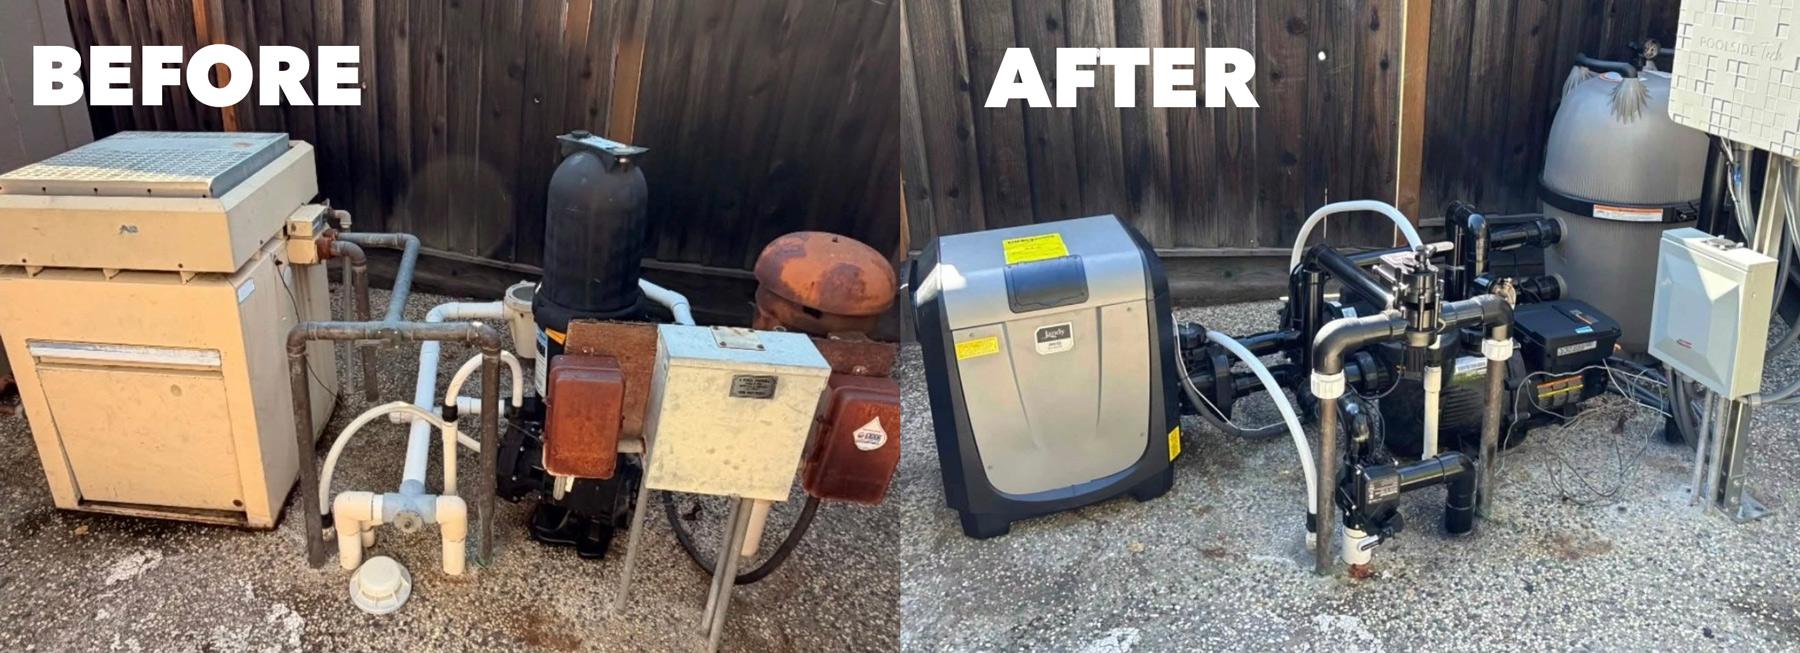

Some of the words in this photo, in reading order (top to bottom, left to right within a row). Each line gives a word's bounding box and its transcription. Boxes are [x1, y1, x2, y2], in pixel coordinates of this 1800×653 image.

[1699, 36, 1758, 57] POOLSIDE
[1760, 41, 1784, 62] Tech
[1041, 328, 1065, 339] Jandy
